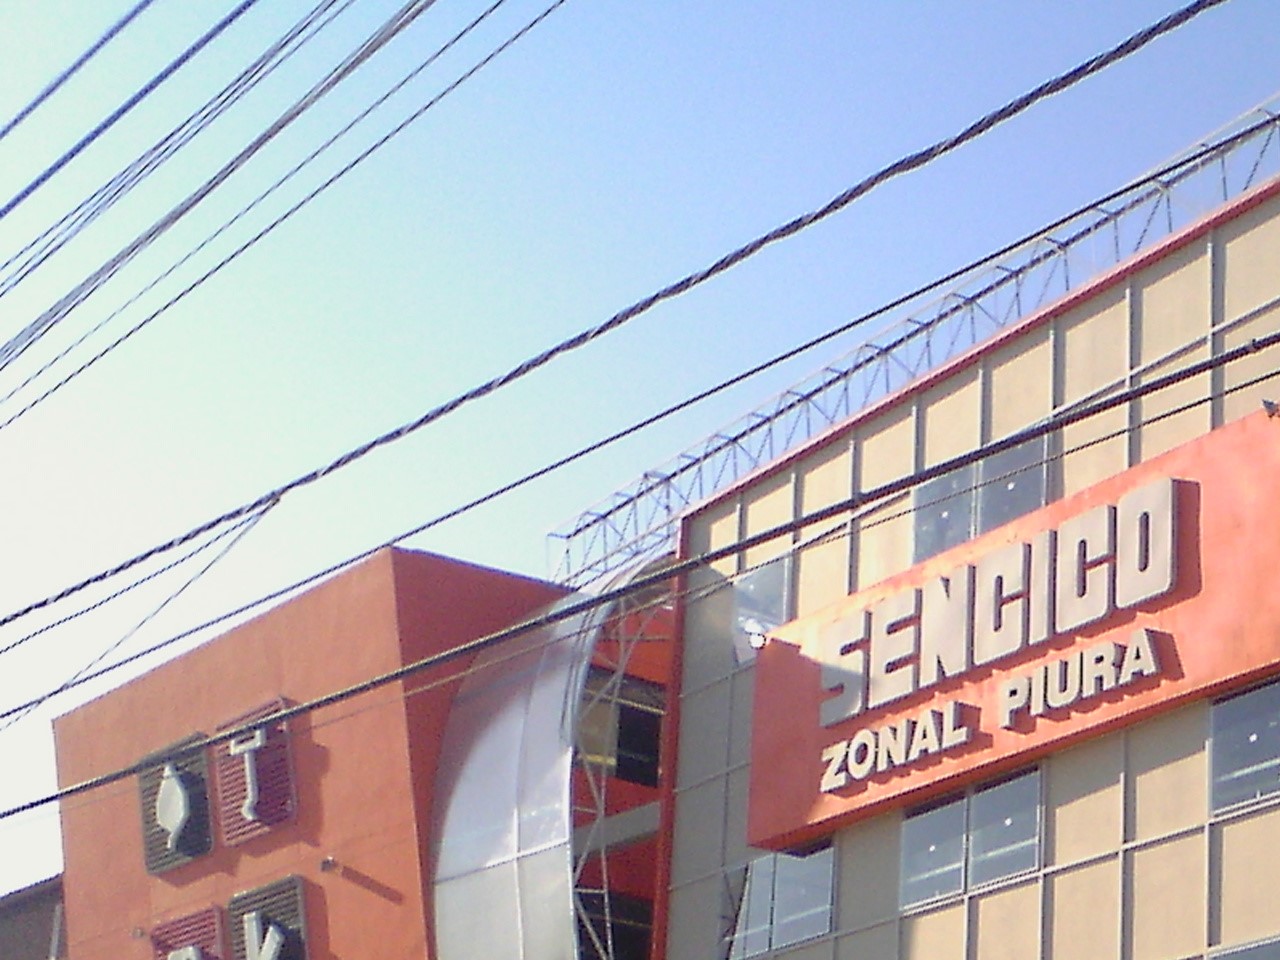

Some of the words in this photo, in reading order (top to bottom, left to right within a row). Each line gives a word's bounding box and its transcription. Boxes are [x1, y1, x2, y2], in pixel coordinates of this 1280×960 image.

[819, 477, 1175, 727] SENCICO
[820, 705, 969, 792] ZONAL
[999, 628, 1158, 728] PIURA
